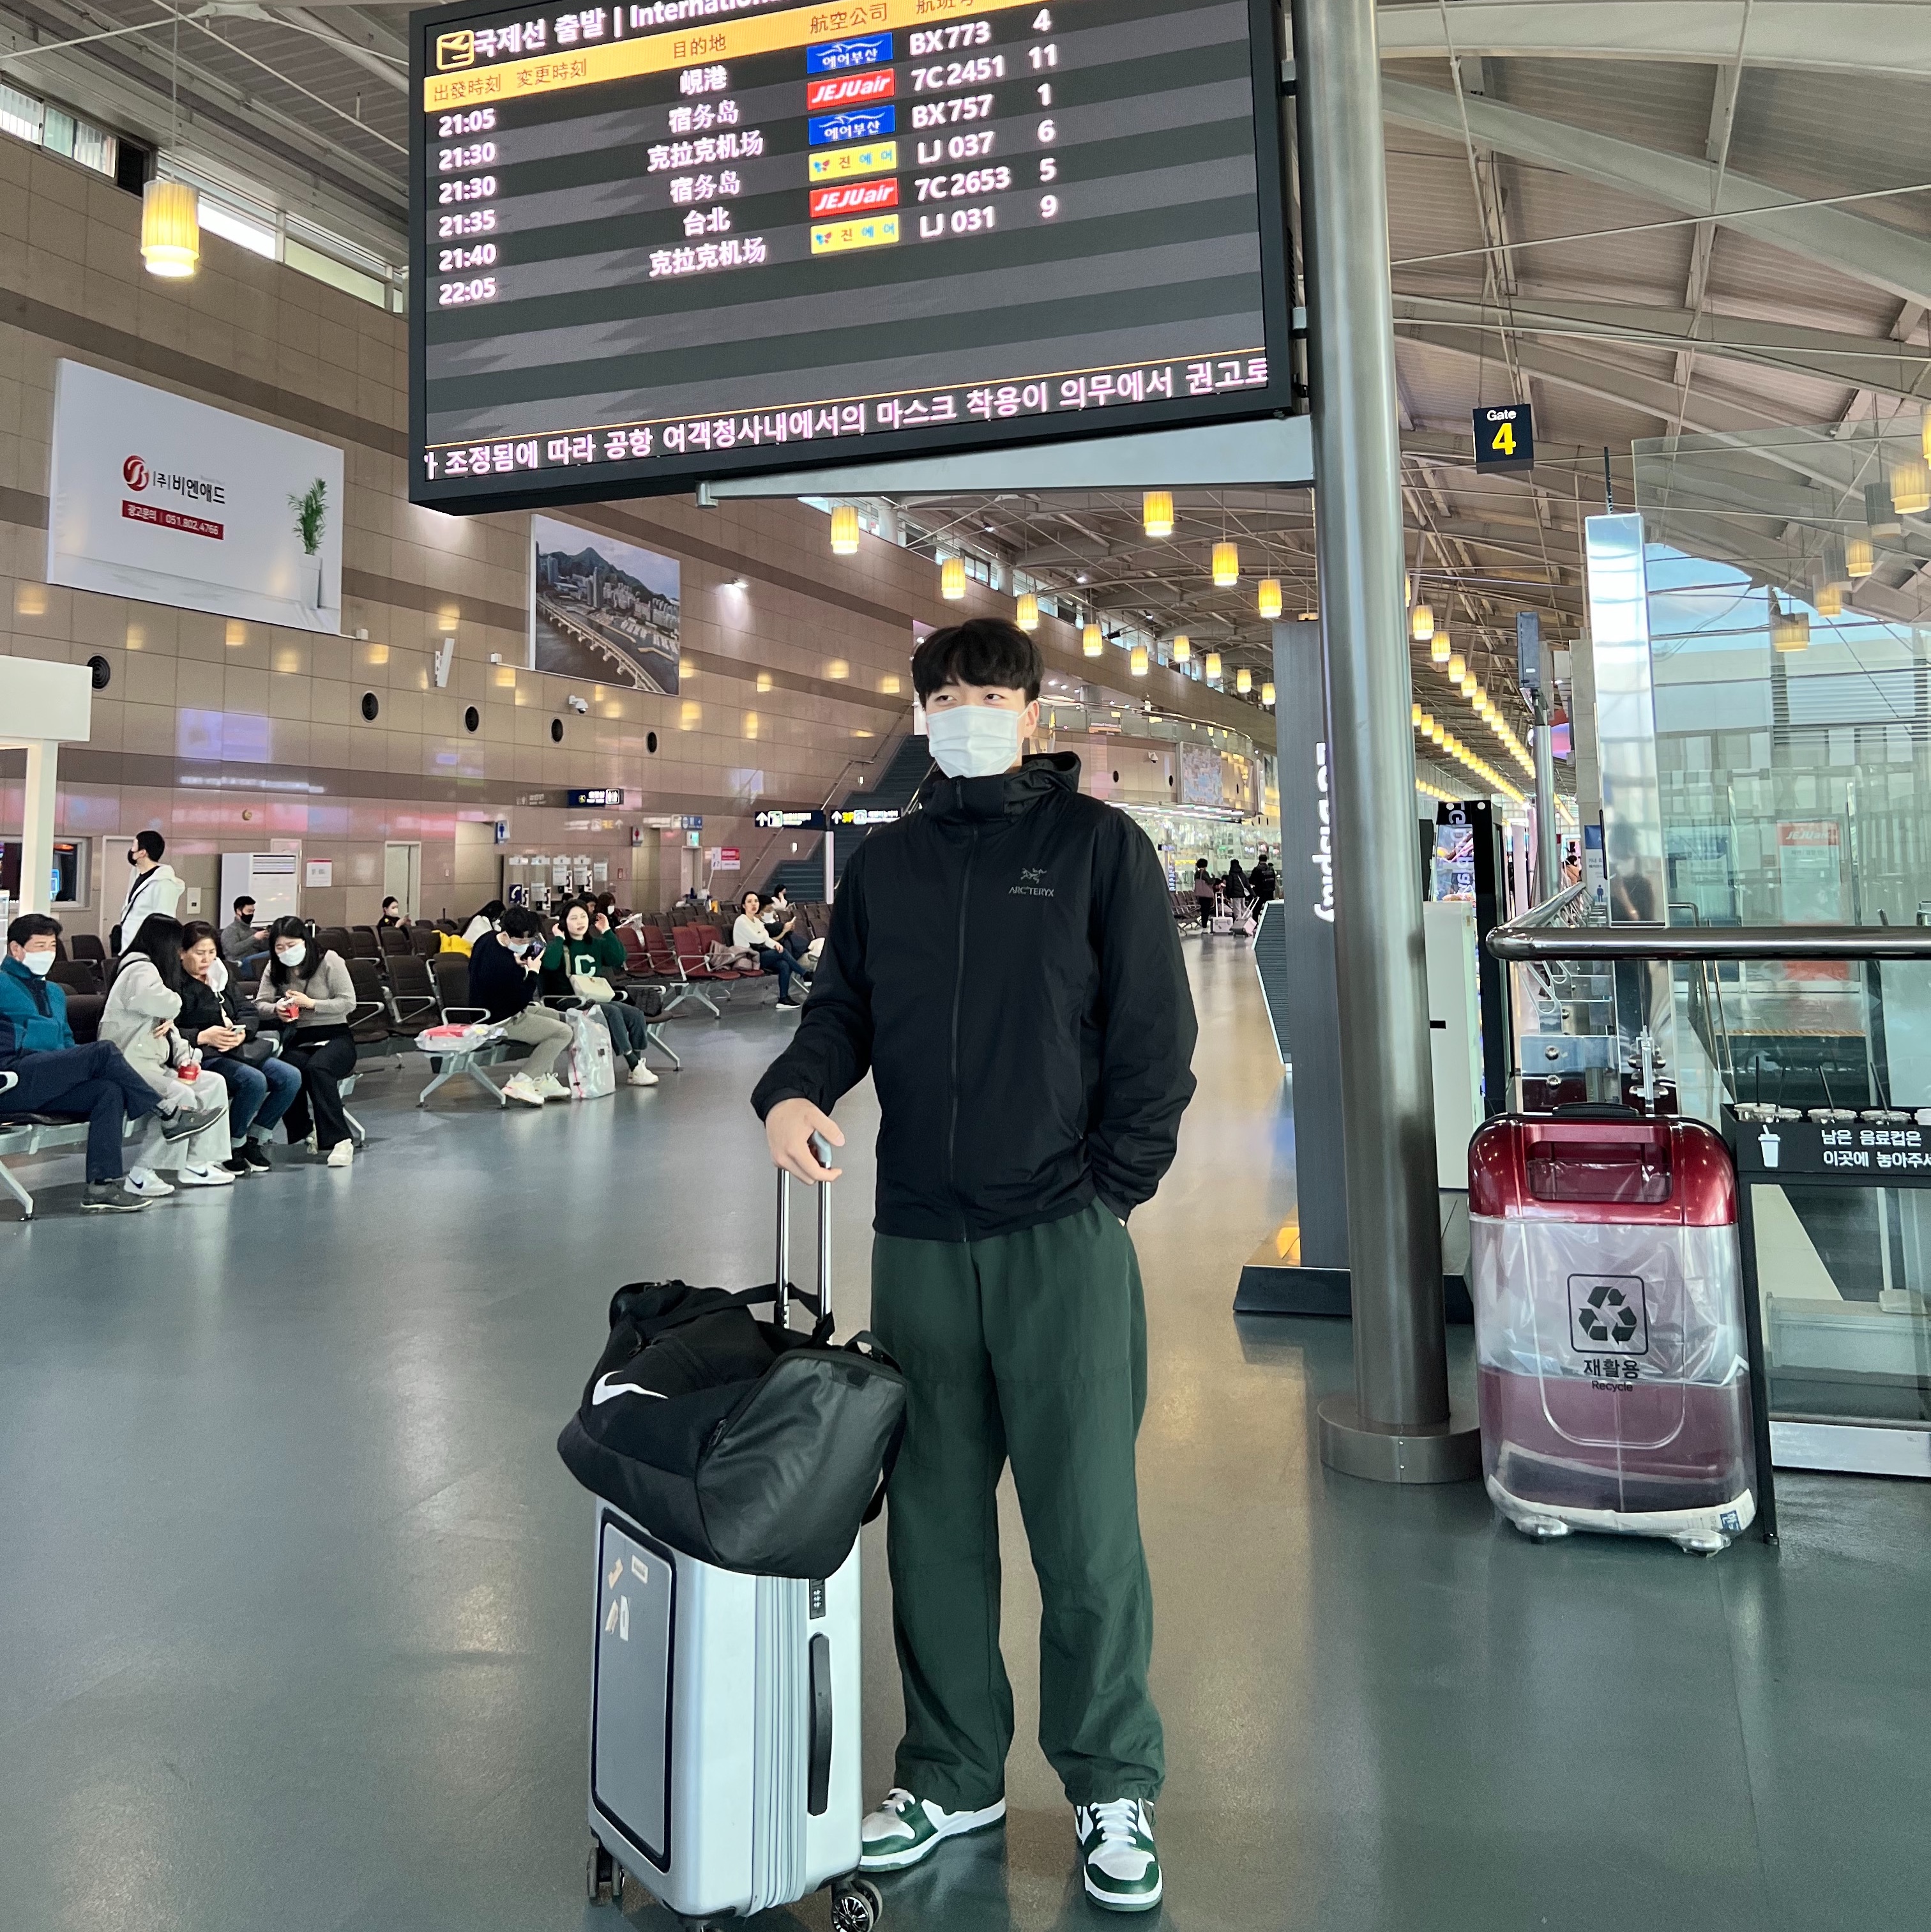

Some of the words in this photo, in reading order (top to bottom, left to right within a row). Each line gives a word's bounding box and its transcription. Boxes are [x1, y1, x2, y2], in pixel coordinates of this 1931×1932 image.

[474, 19, 546, 57] 국제선
[554, 8, 607, 43] 출발
[810, 3, 888, 34] 航空公司
[1032, 8, 1052, 32] 4
[674, 33, 727, 59] 目的地
[822, 48, 878, 68] 에어부산
[1028, 43, 1058, 69] 11
[435, 73, 501, 102] 出發時刻
[812, 75, 891, 103] JEJUair
[1036, 83, 1053, 107] 1
[438, 107, 496, 137] 21:05
[669, 100, 739, 133] 宿务岛
[824, 119, 881, 141] 에어부산
[1037, 119, 1055, 143] 6
[438, 141, 496, 171] 21:30
[647, 130, 764, 172] 克拉克机场
[1040, 158, 1056, 181] 5
[438, 175, 496, 204] 21:30
[670, 170, 741, 204] 宿务岛
[814, 184, 895, 212] JEJUair
[1040, 195, 1058, 218] 9
[438, 209, 496, 237] 21:35
[682, 206, 731, 237] 台北
[438, 243, 497, 271] 21:40
[649, 236, 767, 278] 克拉克机场
[438, 277, 496, 305] 22:05
[444, 439, 538, 475] 조정됨에
[548, 434, 597, 465] 따라
[603, 427, 654, 459] 공항
[663, 402, 865, 453] 여객청사내에서의
[877, 395, 957, 430] 마스크
[966, 381, 1049, 419] 착용이
[1059, 366, 1172, 409] 의무에서
[1185, 357, 1268, 395] 권고로
[1487, 409, 1517, 422] Gate
[1492, 422, 1517, 455] 4
[127, 504, 156, 522] 광고문의
[575, 954, 596, 977] C
[1821, 1129, 1852, 1146] 남은
[1859, 1129, 1921, 1147] 음료컵은
[1823, 1150, 1870, 1168] 이곳에
[1584, 1358, 1640, 1379] 재활용
[1591, 1380, 1633, 1392] Recycle
